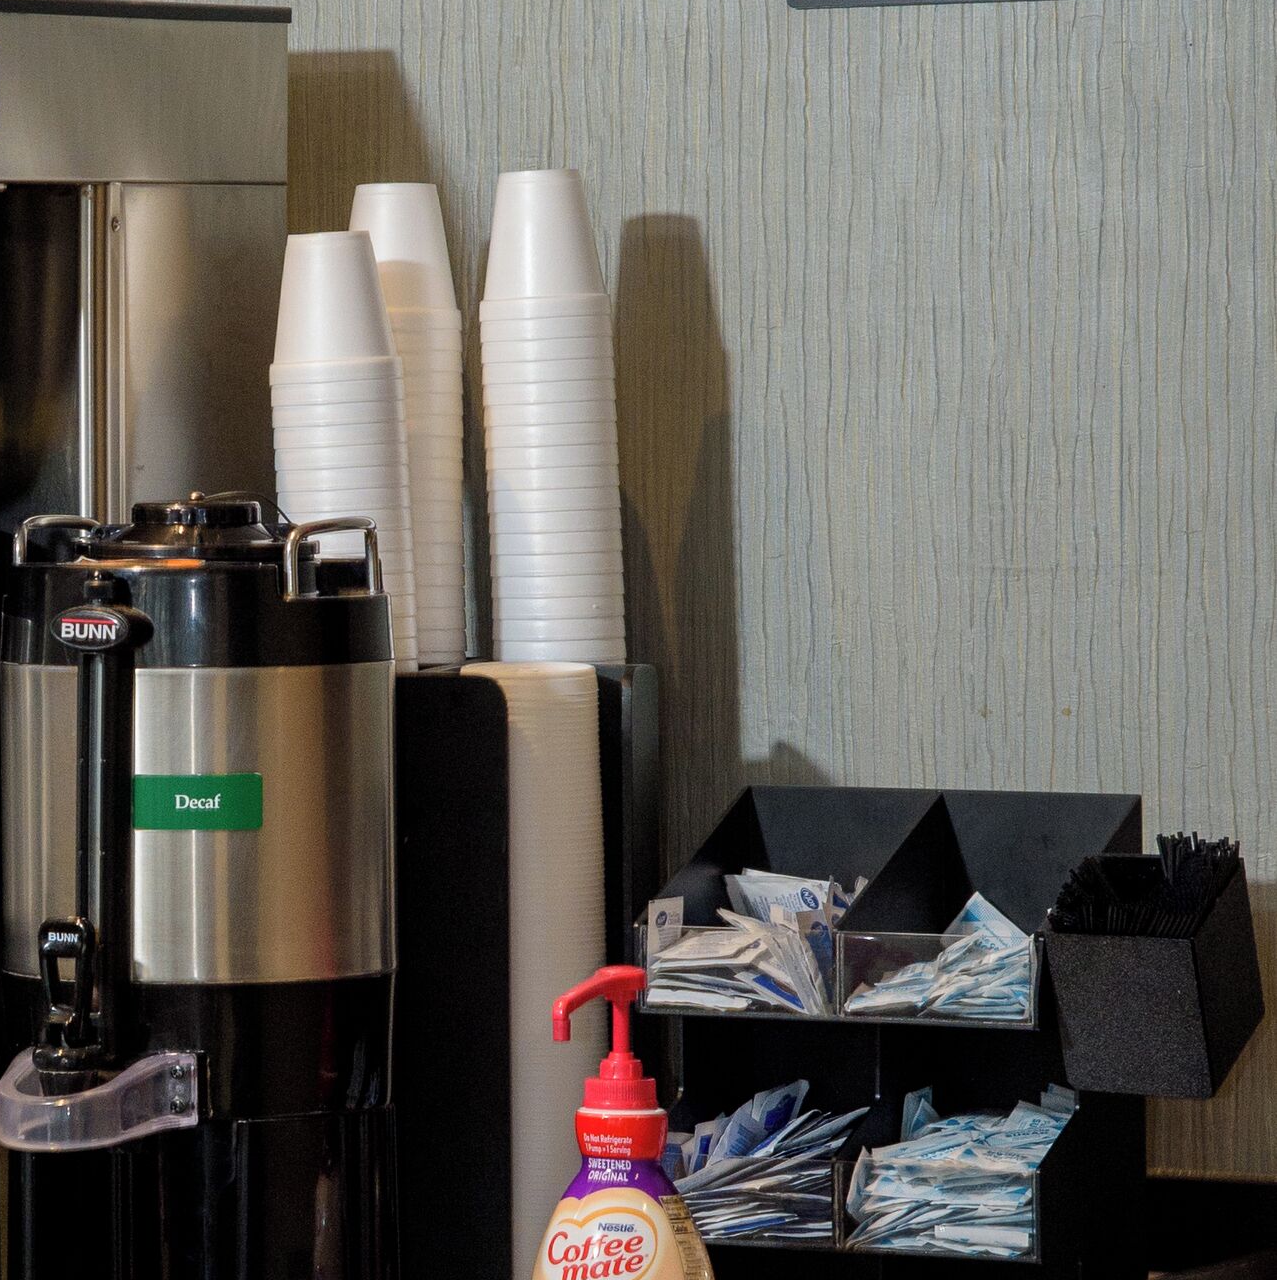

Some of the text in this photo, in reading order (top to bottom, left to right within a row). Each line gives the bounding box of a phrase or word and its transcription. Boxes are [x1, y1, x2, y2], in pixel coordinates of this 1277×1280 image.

[61, 622, 116, 640] BUNN
[175, 793, 221, 809] Decaf
[48, 931, 79, 943] BUNN
[583, 1133, 633, 1146] Do Not Refrigerate
[610, 1144, 631, 1156] Serving
[588, 1157, 631, 1170] SWEETENED
[588, 1170, 629, 1182] ORIGINAL
[548, 1231, 643, 1266] Coffee
